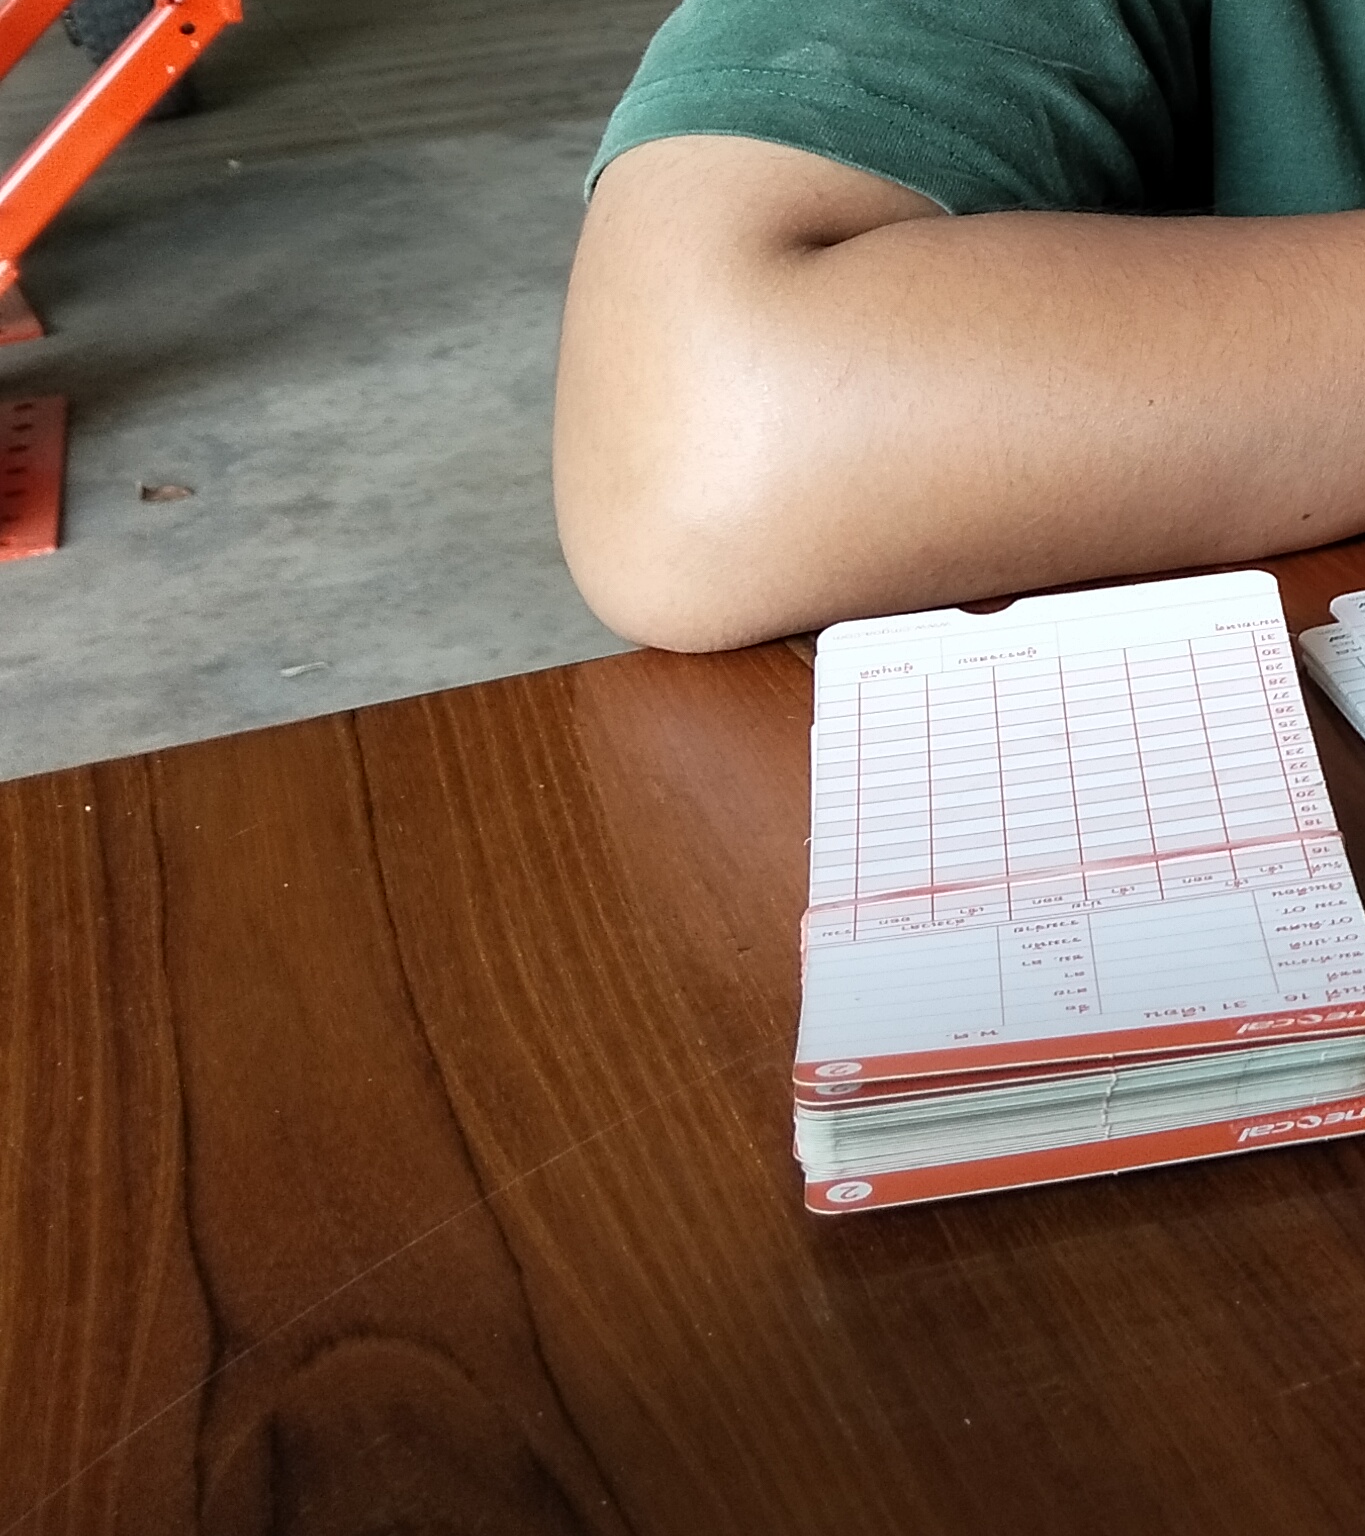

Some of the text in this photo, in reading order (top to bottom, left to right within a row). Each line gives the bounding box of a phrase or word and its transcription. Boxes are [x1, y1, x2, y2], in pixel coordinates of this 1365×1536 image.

[1262, 647, 1281, 657] 30
[1264, 662, 1284, 672] 29
[1268, 676, 1288, 686] 28
[1272, 691, 1290, 701] 27
[1275, 705, 1295, 715] 26
[1278, 719, 1297, 729] 25
[1281, 733, 1301, 743] 24
[1285, 747, 1305, 756] 23
[1289, 761, 1308, 771] 22
[1293, 775, 1311, 784] 21
[1296, 789, 1316, 799] 20
[1300, 803, 1318, 813] 19
[1283, 993, 1311, 1002] 16
[1221, 1000, 1248, 1011] 31
[838, 1181, 861, 1202] 2
